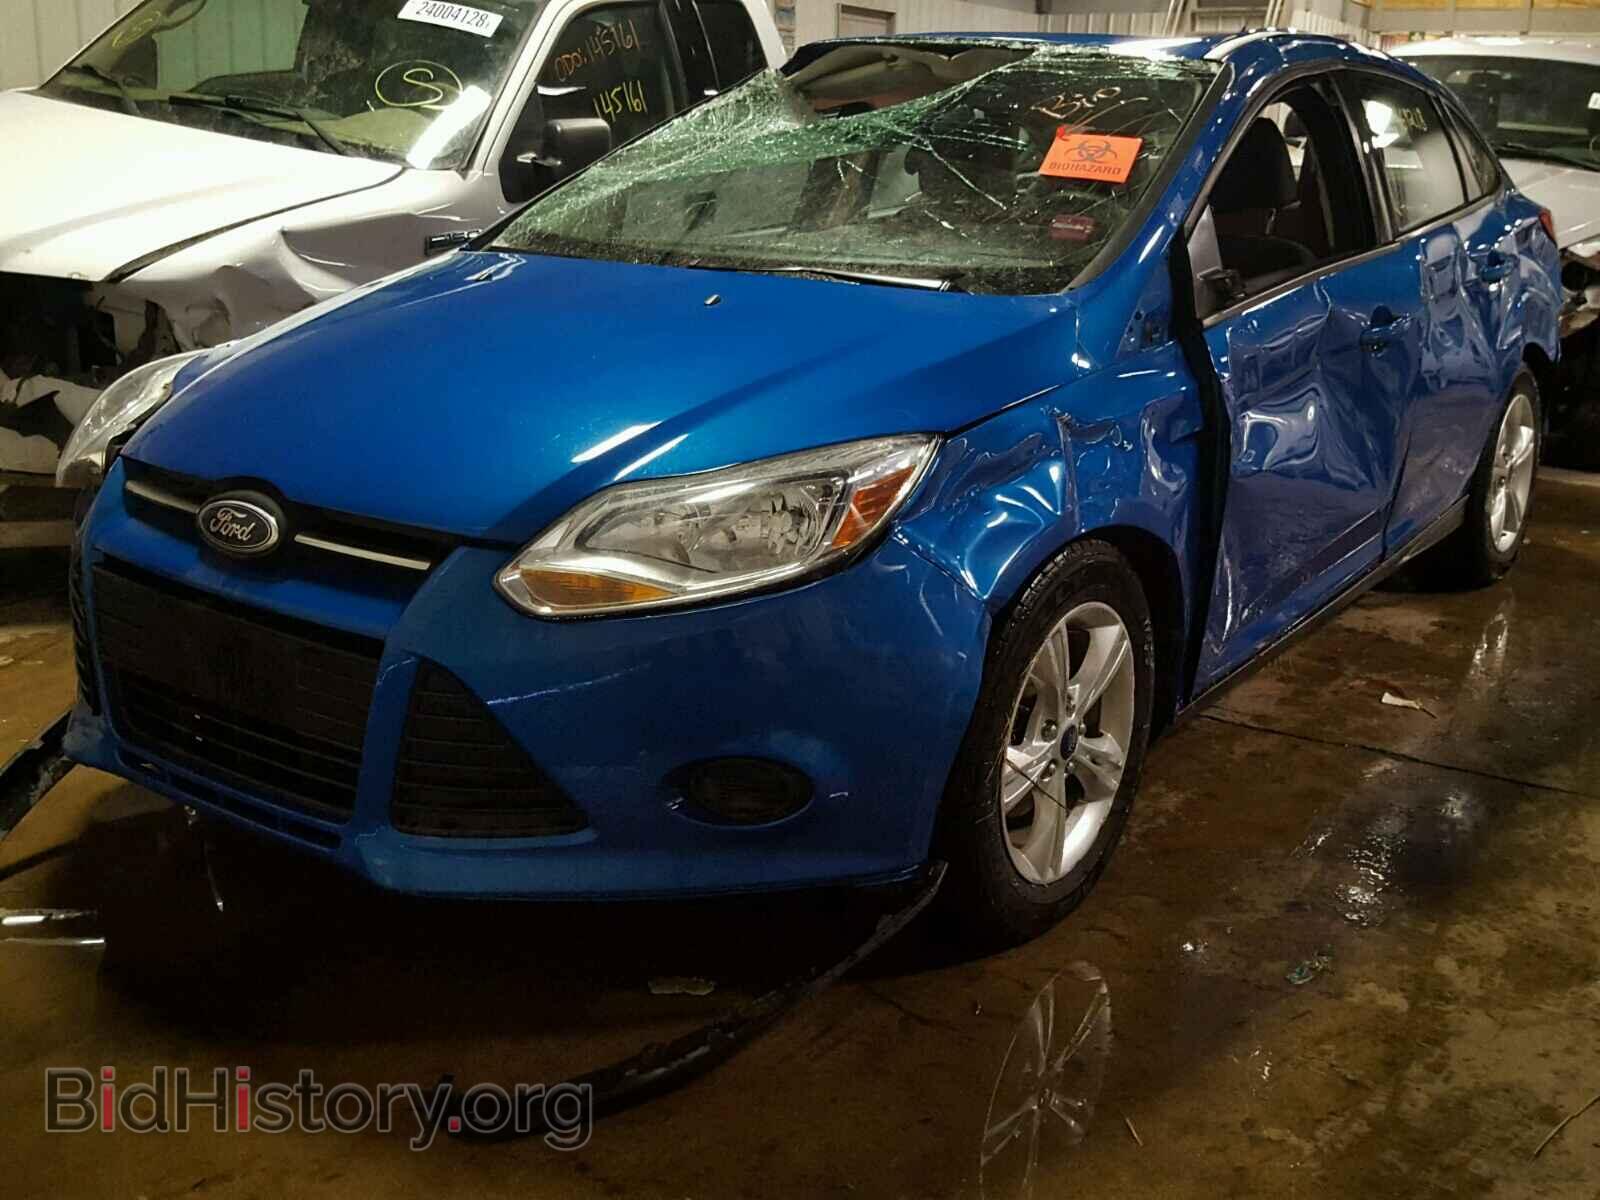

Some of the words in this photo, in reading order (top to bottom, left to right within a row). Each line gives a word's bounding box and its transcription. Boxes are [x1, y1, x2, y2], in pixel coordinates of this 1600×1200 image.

[416, 1, 489, 27] 24004128
[593, 79, 648, 122] 145161
[1048, 161, 1122, 176] BIOHAZARD
[209, 507, 256, 541] Ford
